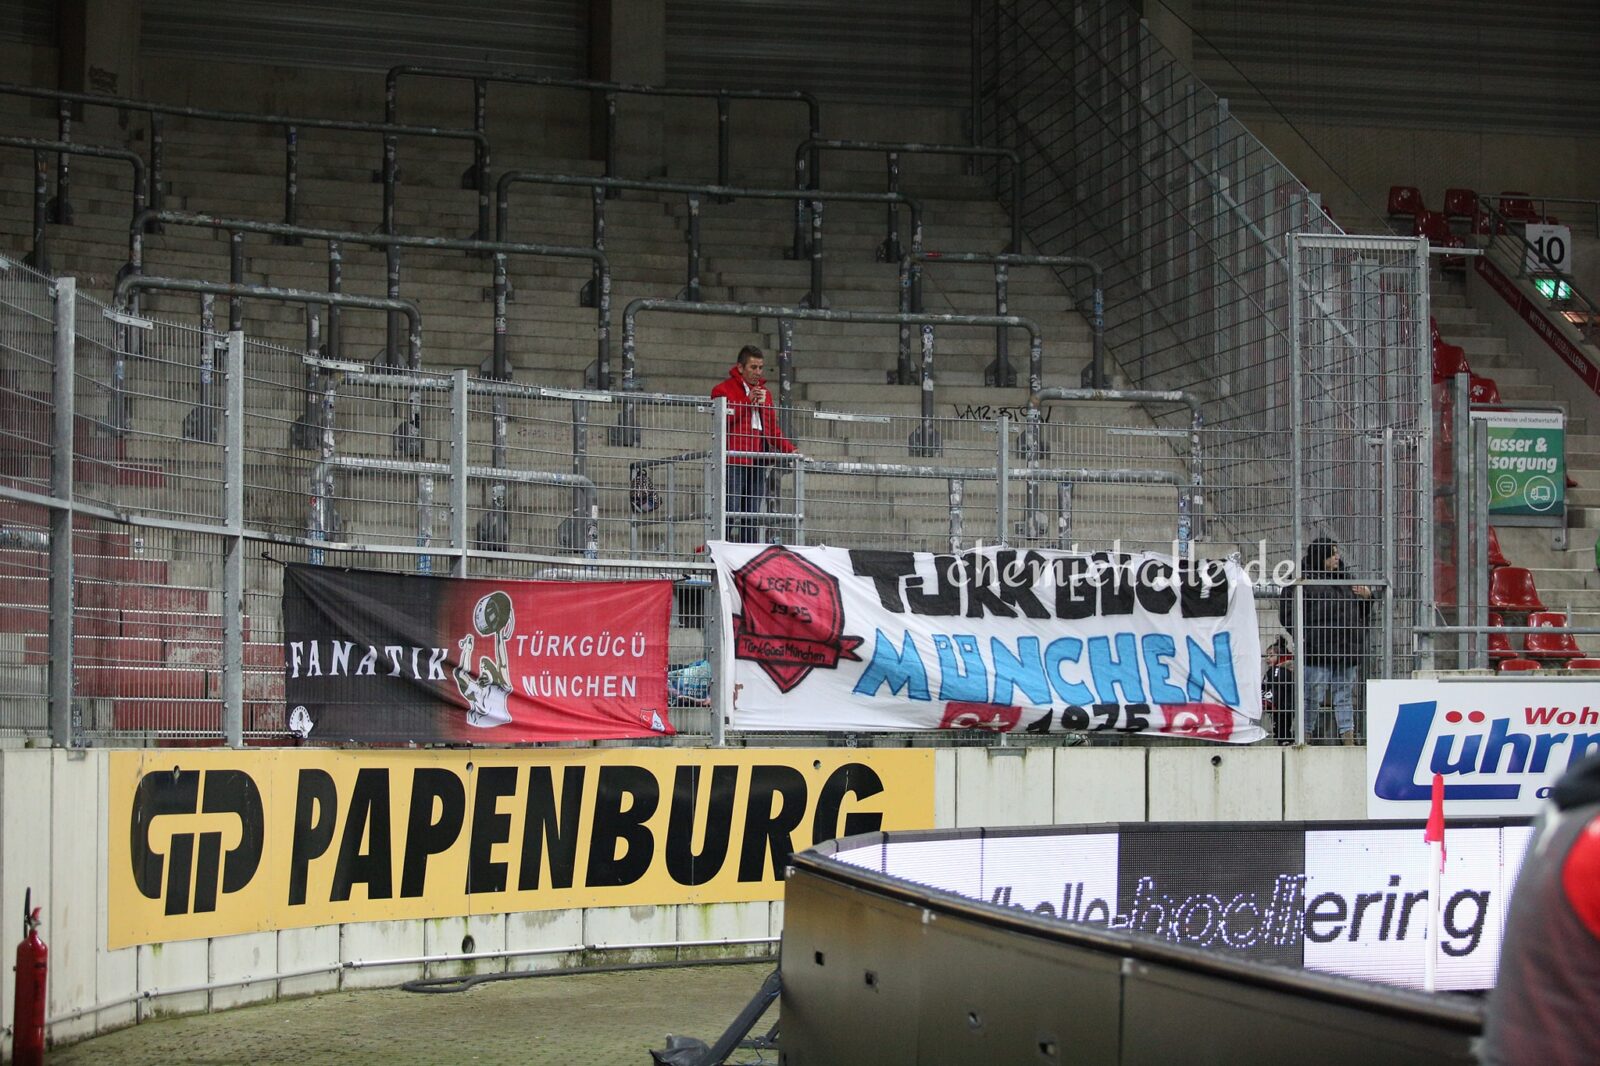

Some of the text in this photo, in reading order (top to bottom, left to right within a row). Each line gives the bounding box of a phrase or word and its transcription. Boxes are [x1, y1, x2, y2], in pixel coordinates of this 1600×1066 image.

[1533, 236, 1566, 266] 10
[1535, 437, 1548, 453] &
[1489, 455, 1557, 473] tsorgung
[758, 577, 819, 596] LEGEND
[516, 631, 646, 658] TÜRKGÜCÜ
[290, 640, 449, 680] FANATIK
[852, 628, 1240, 707] MÜNCHEN
[521, 671, 637, 697] MÜNCHEN
[1026, 703, 1151, 734] 1975
[288, 762, 885, 906] PAPENBURG
